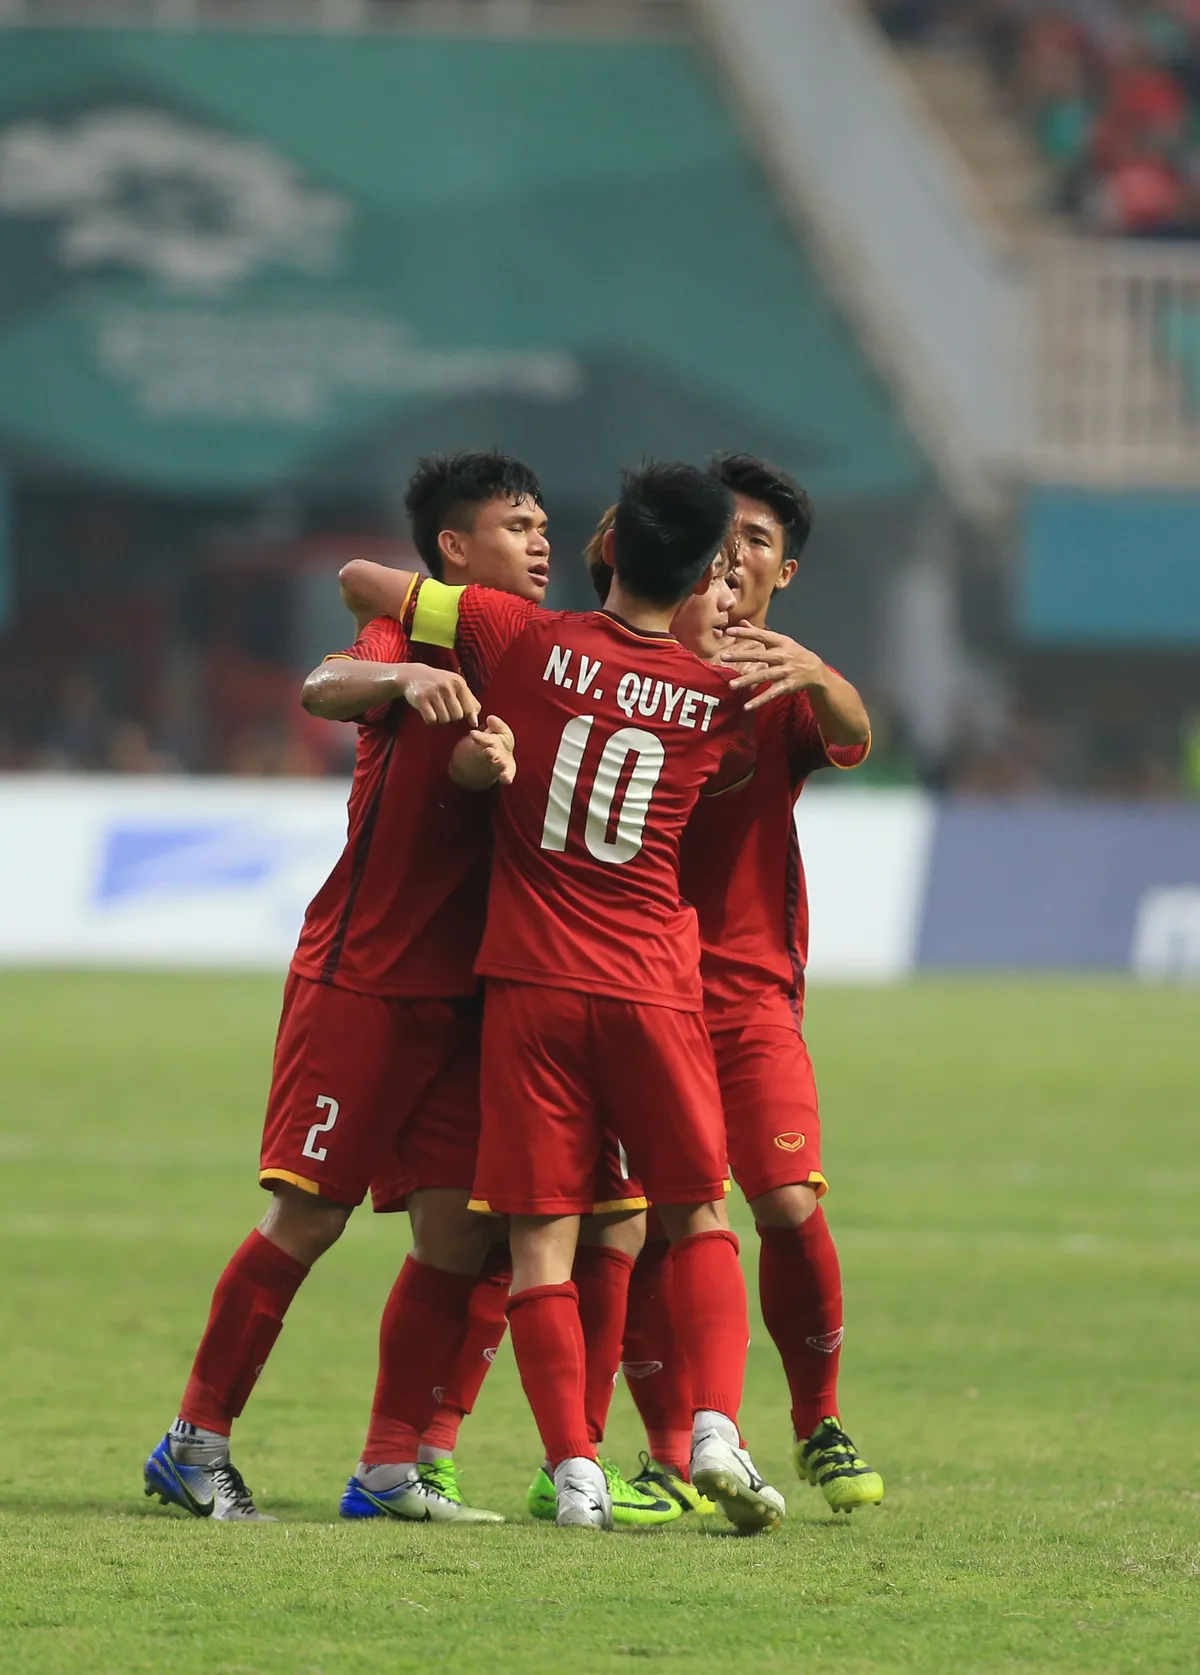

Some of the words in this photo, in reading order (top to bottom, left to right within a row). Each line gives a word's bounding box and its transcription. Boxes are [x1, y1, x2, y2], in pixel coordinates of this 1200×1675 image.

[542, 644, 604, 700] N.V.
[616, 672, 720, 732] QUYET
[540, 714, 665, 864] 10
[302, 1094, 340, 1162] 2
